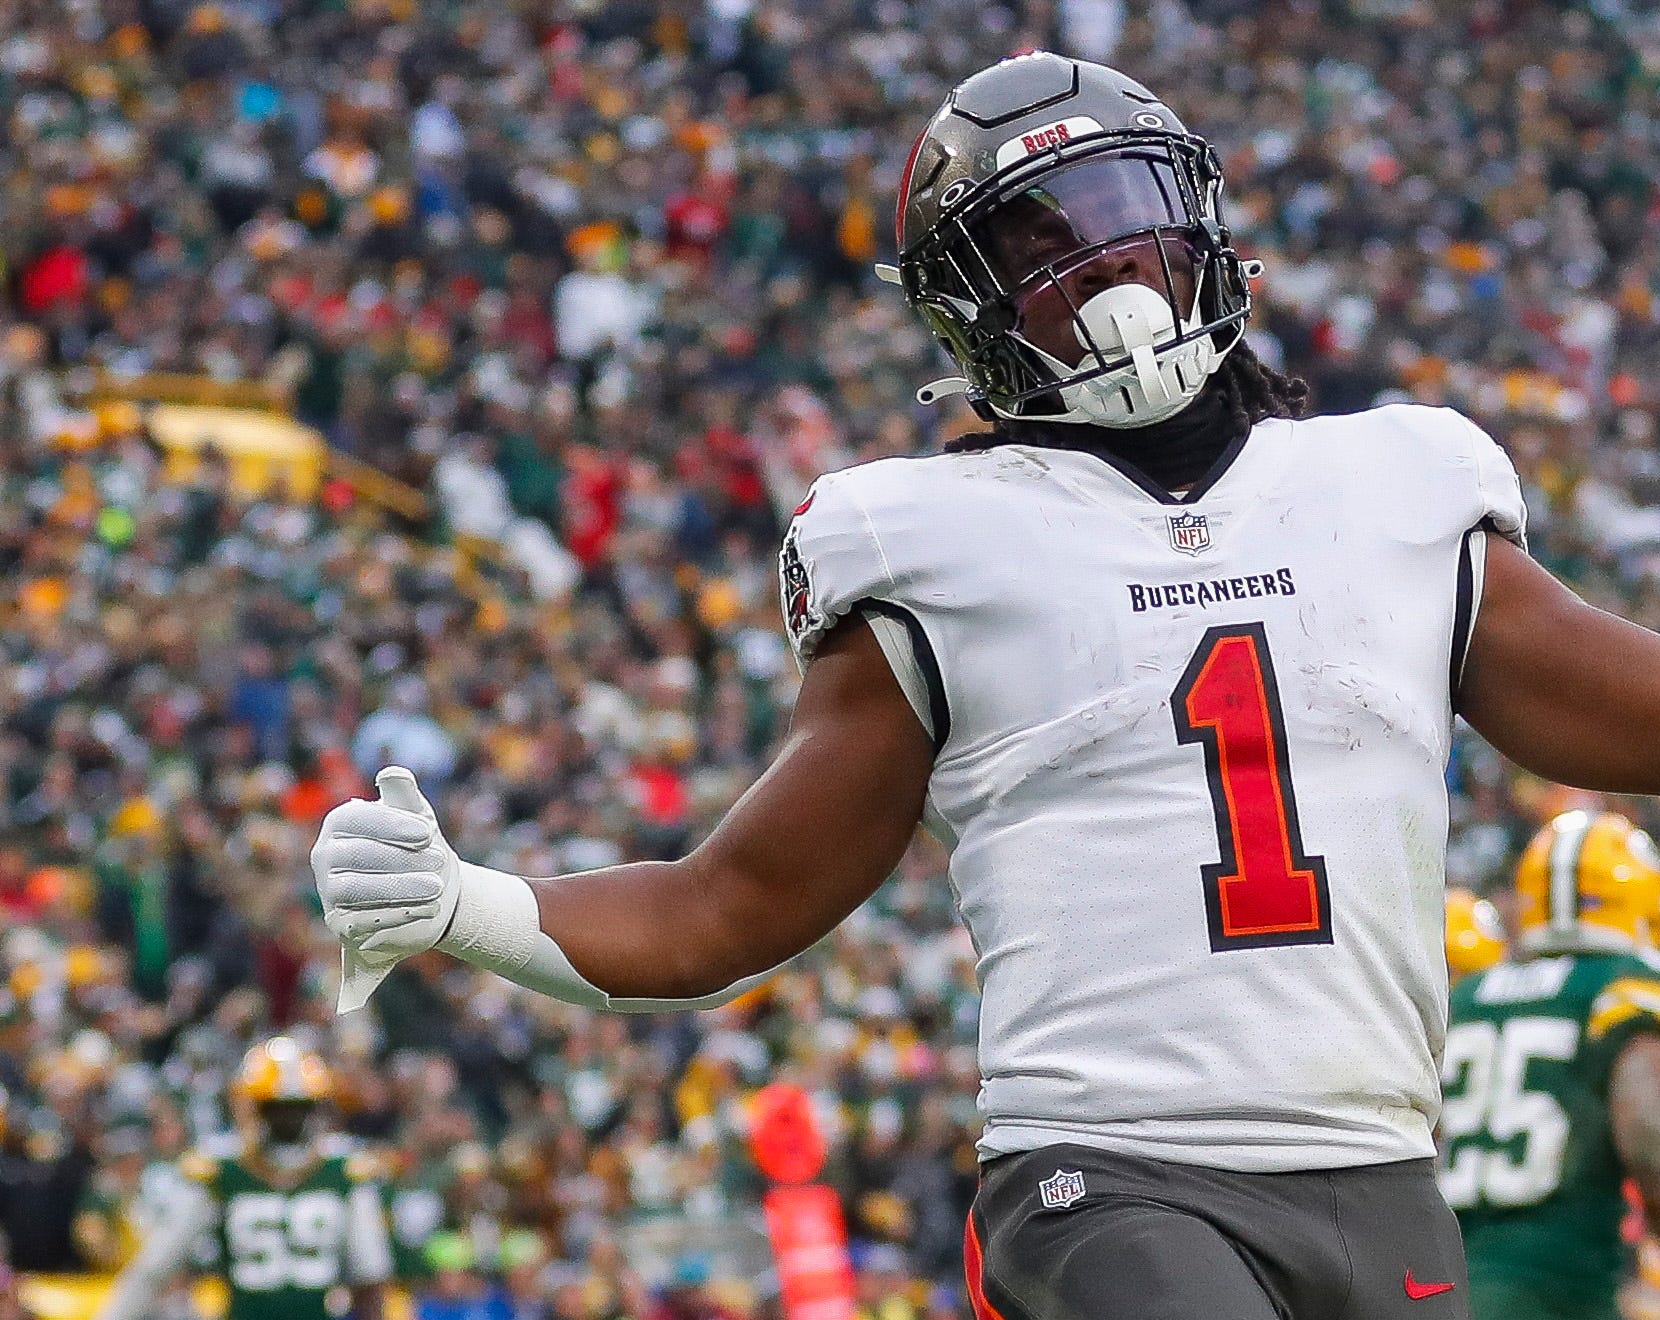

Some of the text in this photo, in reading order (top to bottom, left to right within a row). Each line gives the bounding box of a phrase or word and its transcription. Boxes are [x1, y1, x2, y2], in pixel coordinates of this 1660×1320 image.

[1021, 123, 1071, 154] BUCS
[1176, 528, 1207, 547] NFL
[1127, 567, 1296, 612] BUCCANEERS
[1169, 621, 1334, 953] 1
[1440, 1017, 1579, 1206] 25
[1048, 1184, 1079, 1202] NFL
[225, 1190, 345, 1290] 59
